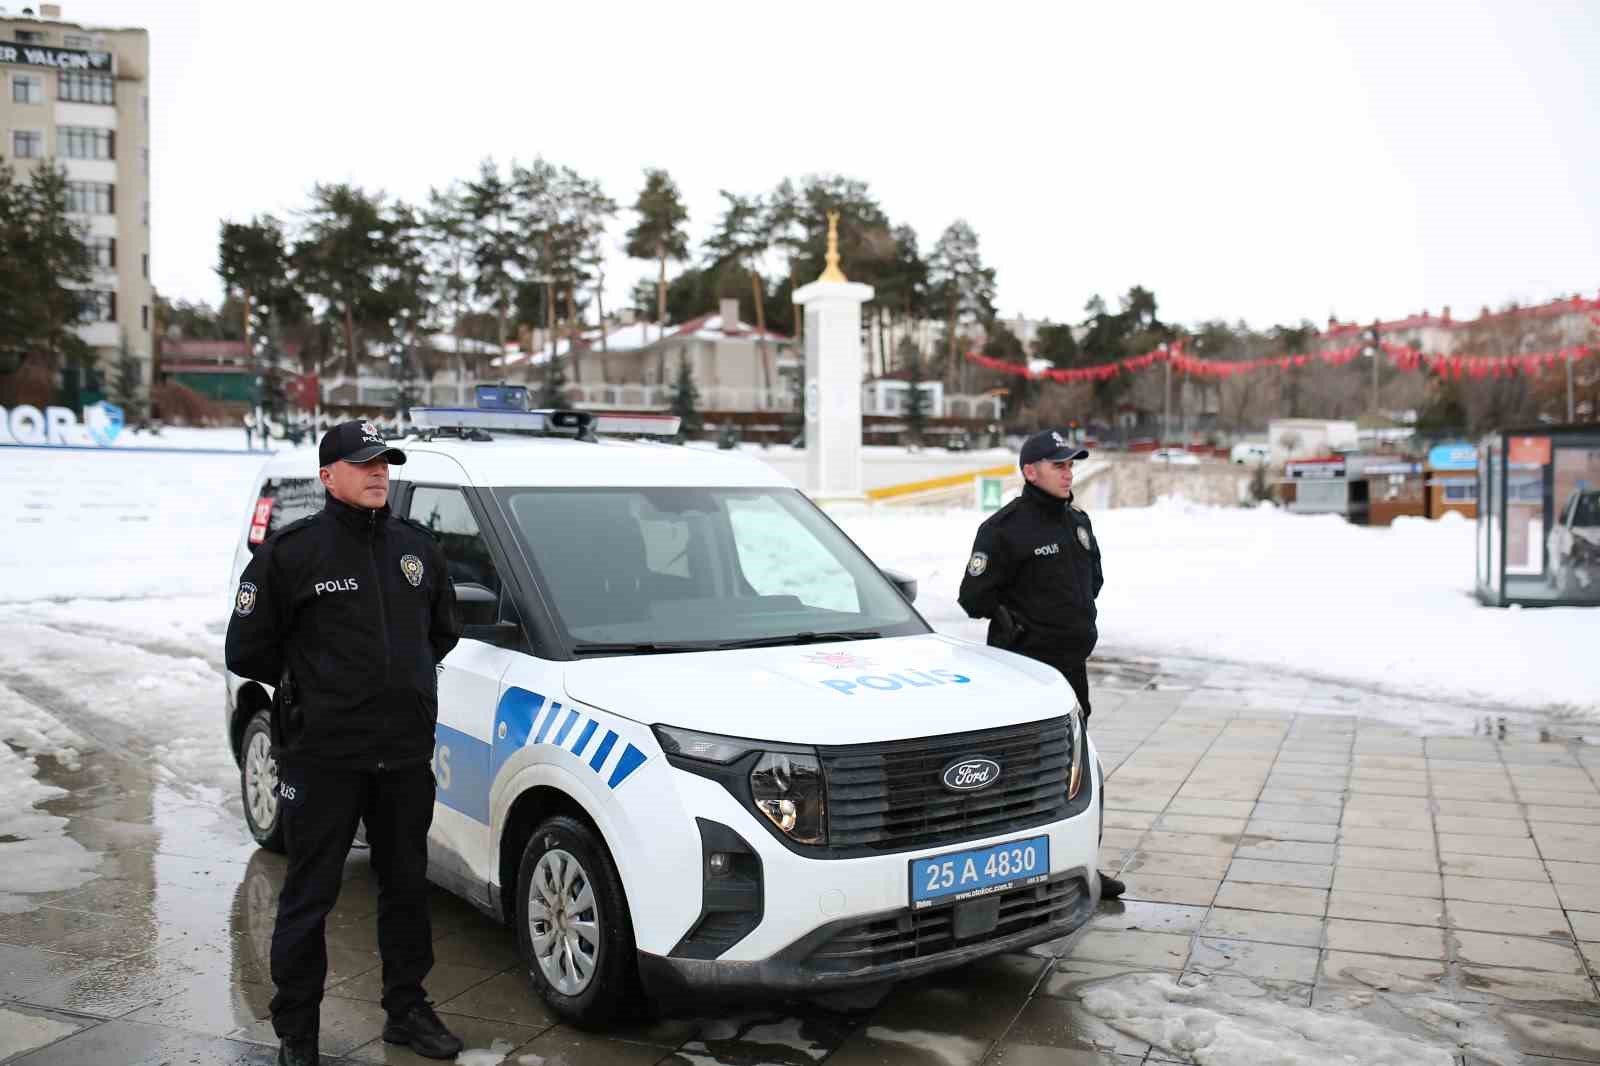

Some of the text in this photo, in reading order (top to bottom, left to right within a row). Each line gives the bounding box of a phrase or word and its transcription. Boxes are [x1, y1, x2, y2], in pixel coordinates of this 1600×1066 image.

[955, 763, 990, 785] Ford
[926, 847, 1035, 891] 25 A 4830
